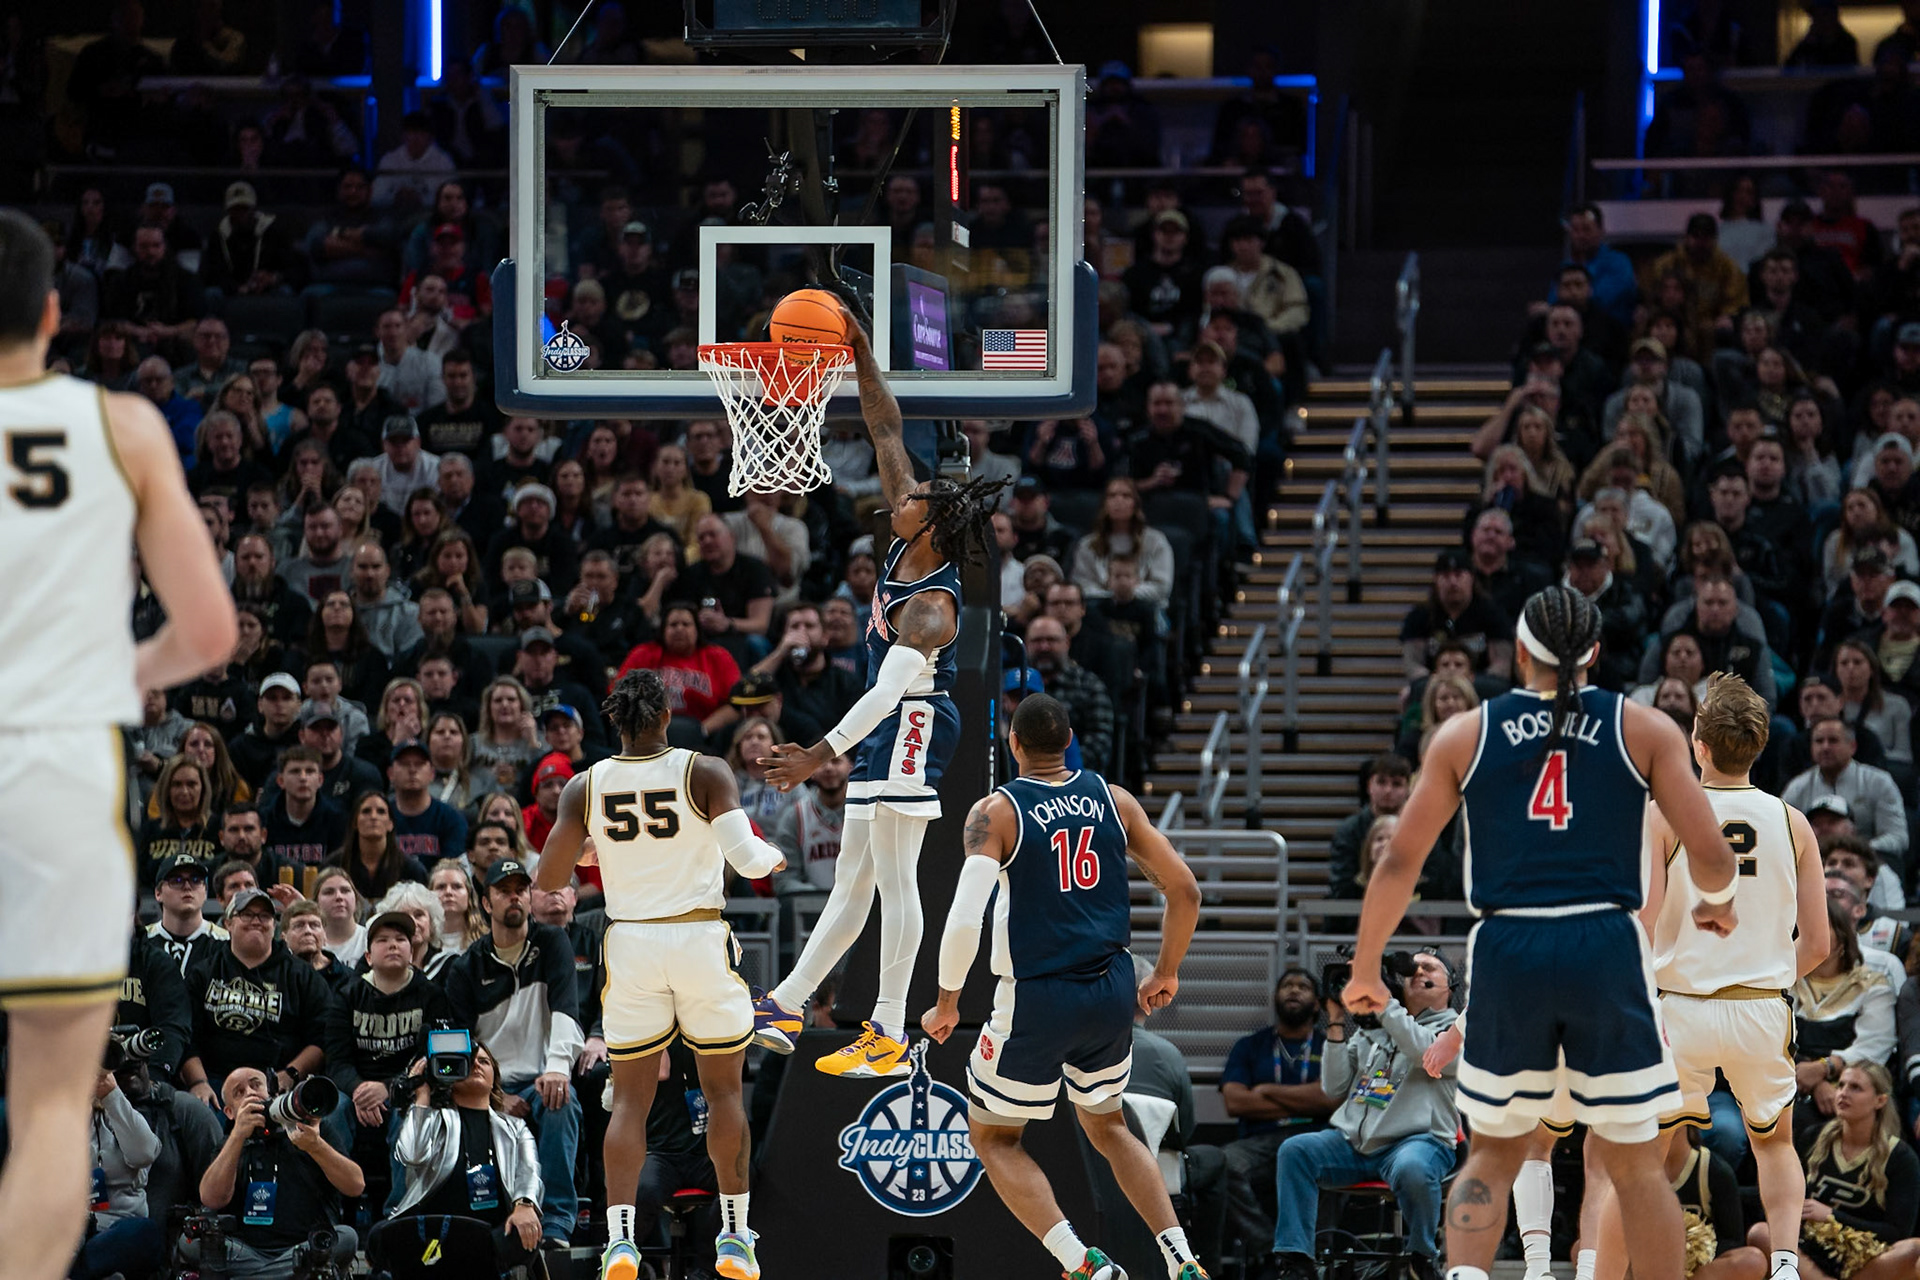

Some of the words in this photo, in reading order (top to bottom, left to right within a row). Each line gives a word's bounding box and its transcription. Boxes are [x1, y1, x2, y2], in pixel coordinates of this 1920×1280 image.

[901, 711, 926, 775] CATS
[600, 787, 681, 842] 55
[1027, 794, 1105, 833] JOHNSON
[1527, 749, 1573, 831] 4
[1050, 826, 1101, 892] 16
[1719, 820, 1758, 877] 2
[912, 1188, 926, 1202] 23
